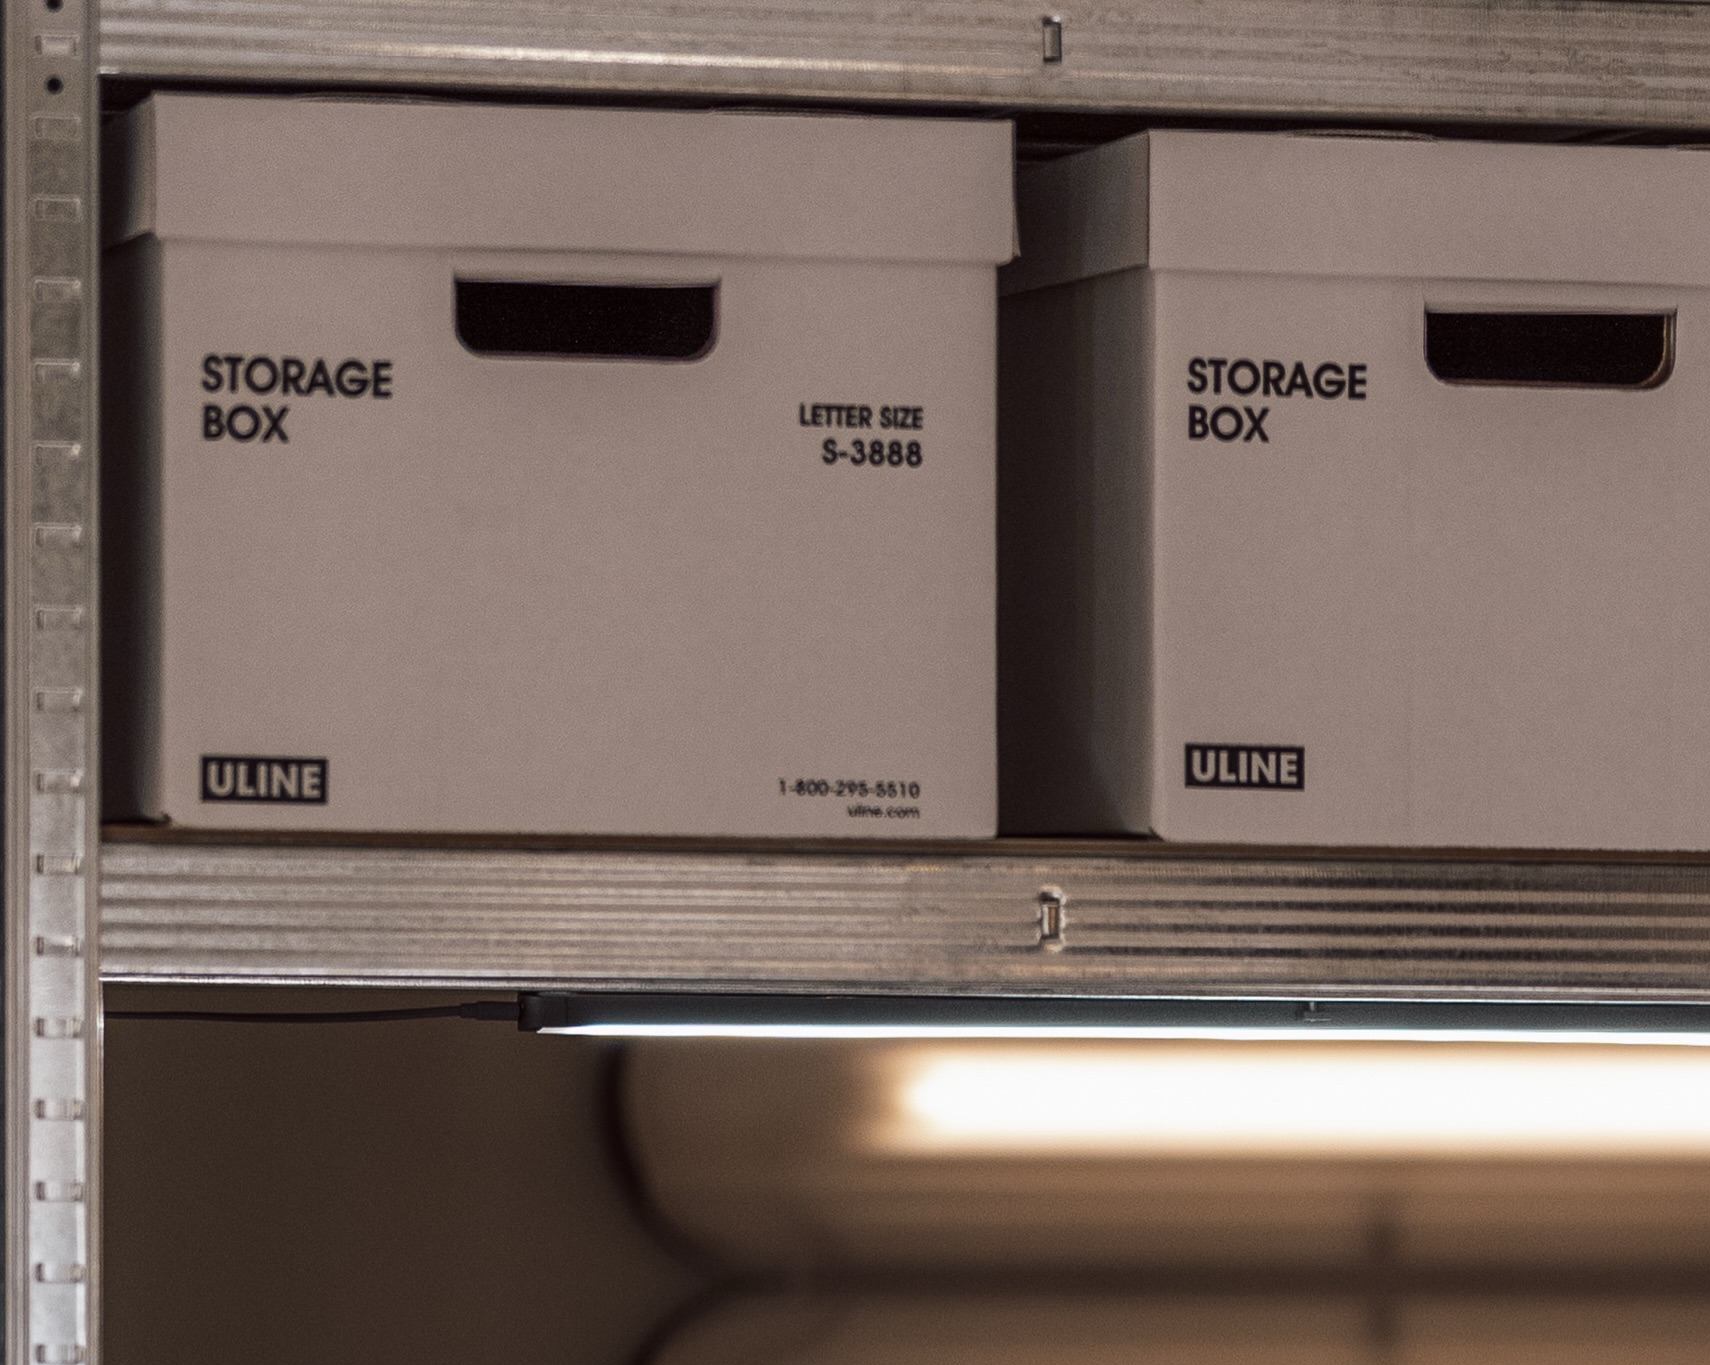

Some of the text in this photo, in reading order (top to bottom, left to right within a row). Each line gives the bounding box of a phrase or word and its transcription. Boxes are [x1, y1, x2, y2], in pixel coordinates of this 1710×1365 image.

[202, 354, 392, 399] STORAGE
[1187, 357, 1367, 400] STORAGE
[203, 404, 289, 443] BOX
[799, 403, 923, 430] LETTER SIZE
[1188, 405, 1269, 442] BOX
[822, 438, 923, 467] S-3888
[207, 761, 321, 798] ULINE
[1192, 750, 1297, 784] ULINE
[780, 779, 920, 799] 1-800-295-5510
[847, 805, 920, 818] uline.com
